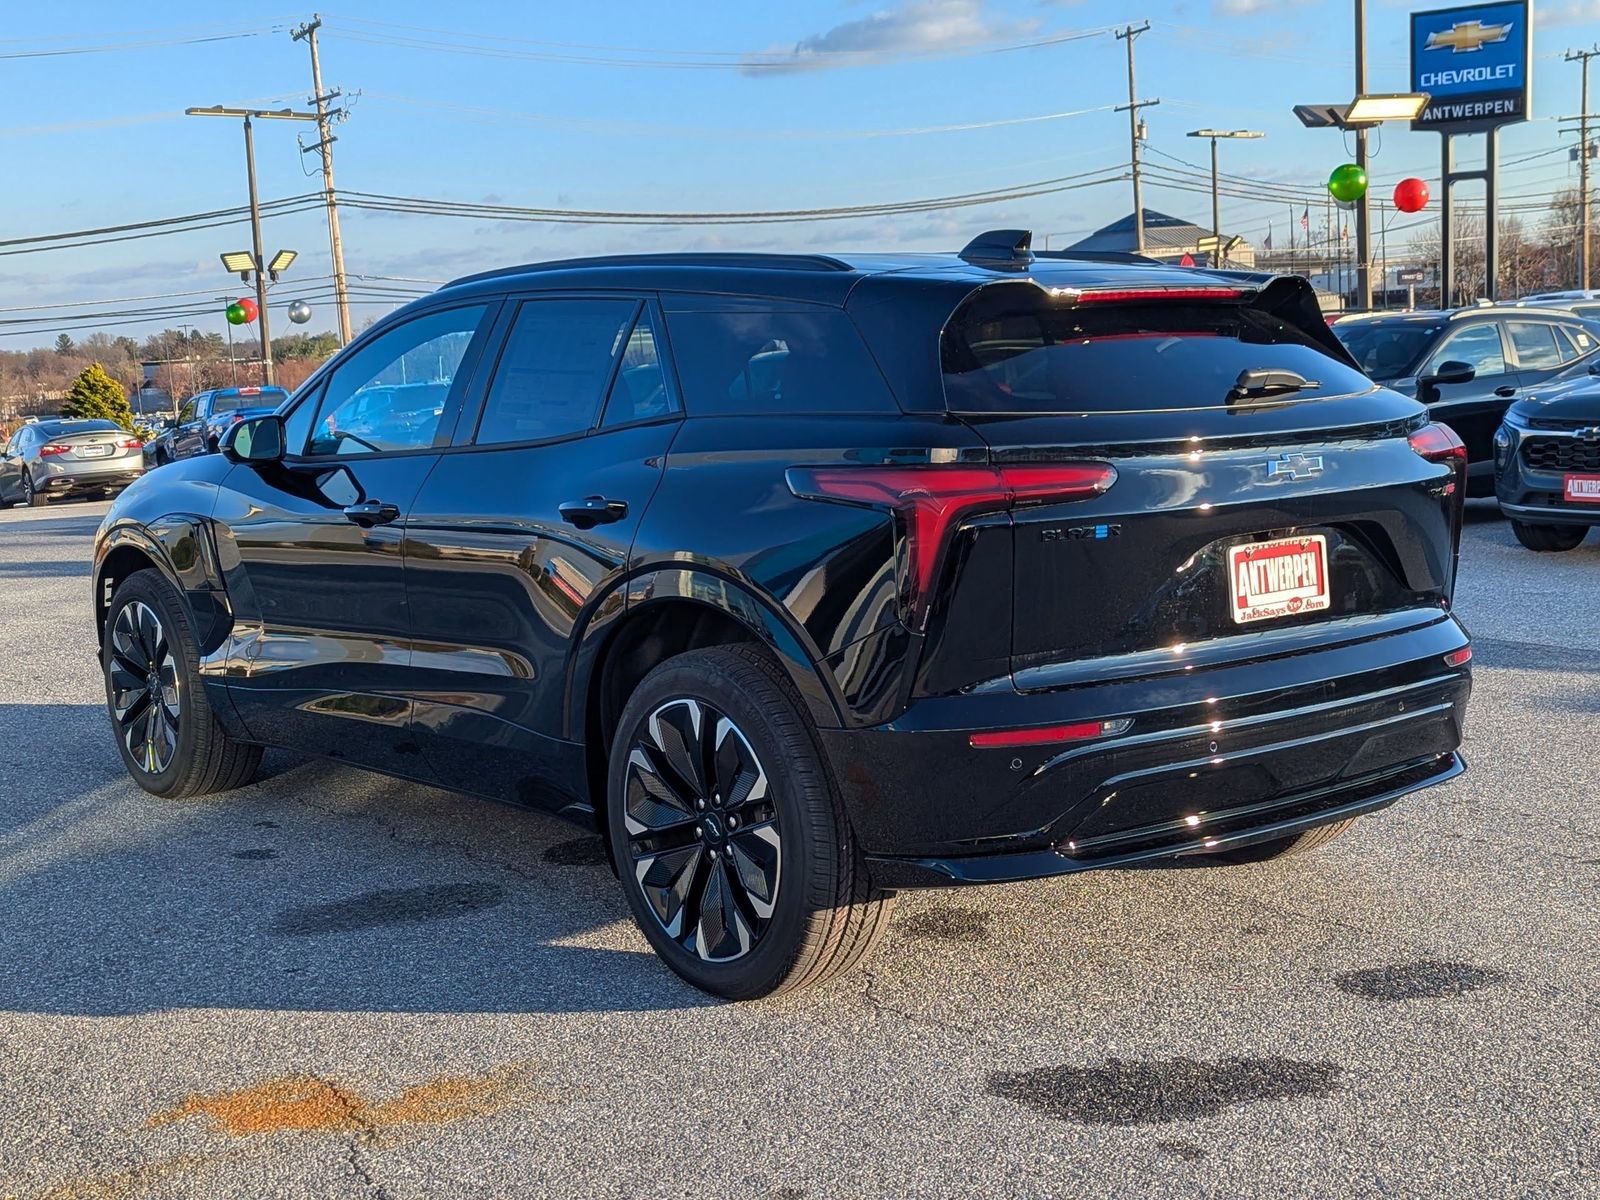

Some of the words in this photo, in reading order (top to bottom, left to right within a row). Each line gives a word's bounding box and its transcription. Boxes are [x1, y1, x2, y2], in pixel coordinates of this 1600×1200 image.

[1420, 63, 1517, 87] CHEVROLET
[1423, 99, 1514, 121] ANTWERPEN
[1237, 551, 1318, 598] ANTWERPEN
